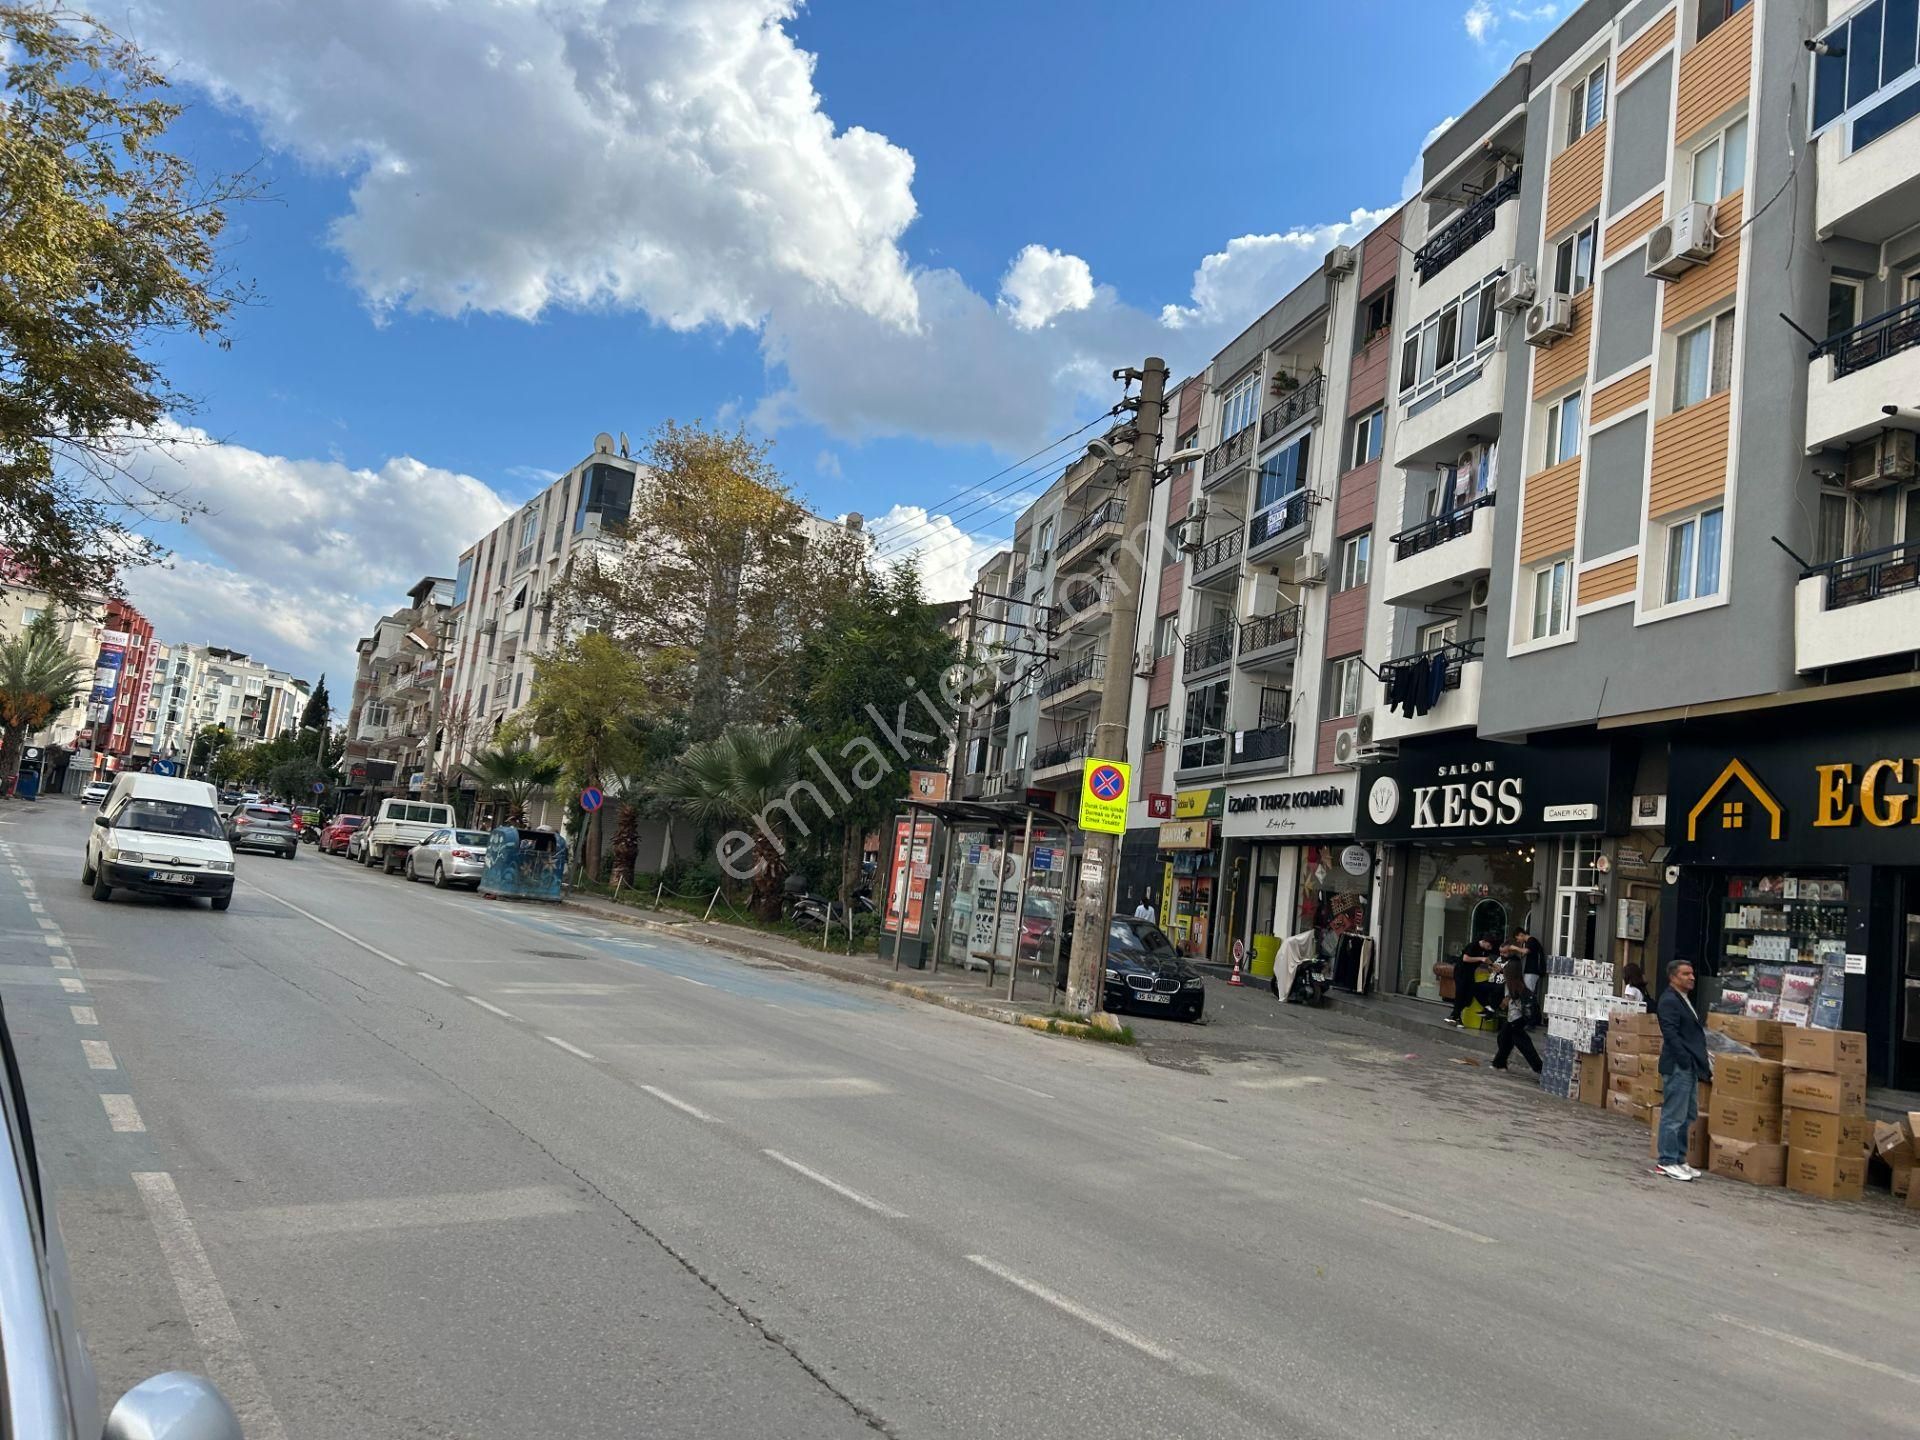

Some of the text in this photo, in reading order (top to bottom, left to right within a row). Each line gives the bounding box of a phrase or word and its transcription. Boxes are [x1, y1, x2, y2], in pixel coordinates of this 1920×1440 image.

[135, 644, 158, 729] EVEREST
[1438, 761, 1495, 776] SALON
[1228, 794, 1257, 813] İZMİR
[1259, 792, 1291, 811] TARZ
[1291, 786, 1344, 808] KOMBİN
[1411, 778, 1523, 828] KESS
[1813, 758, 1920, 828] EG
[1085, 809, 1103, 817] Durmak
[1111, 812, 1122, 820] Park
[1548, 809, 1571, 818] CANER
